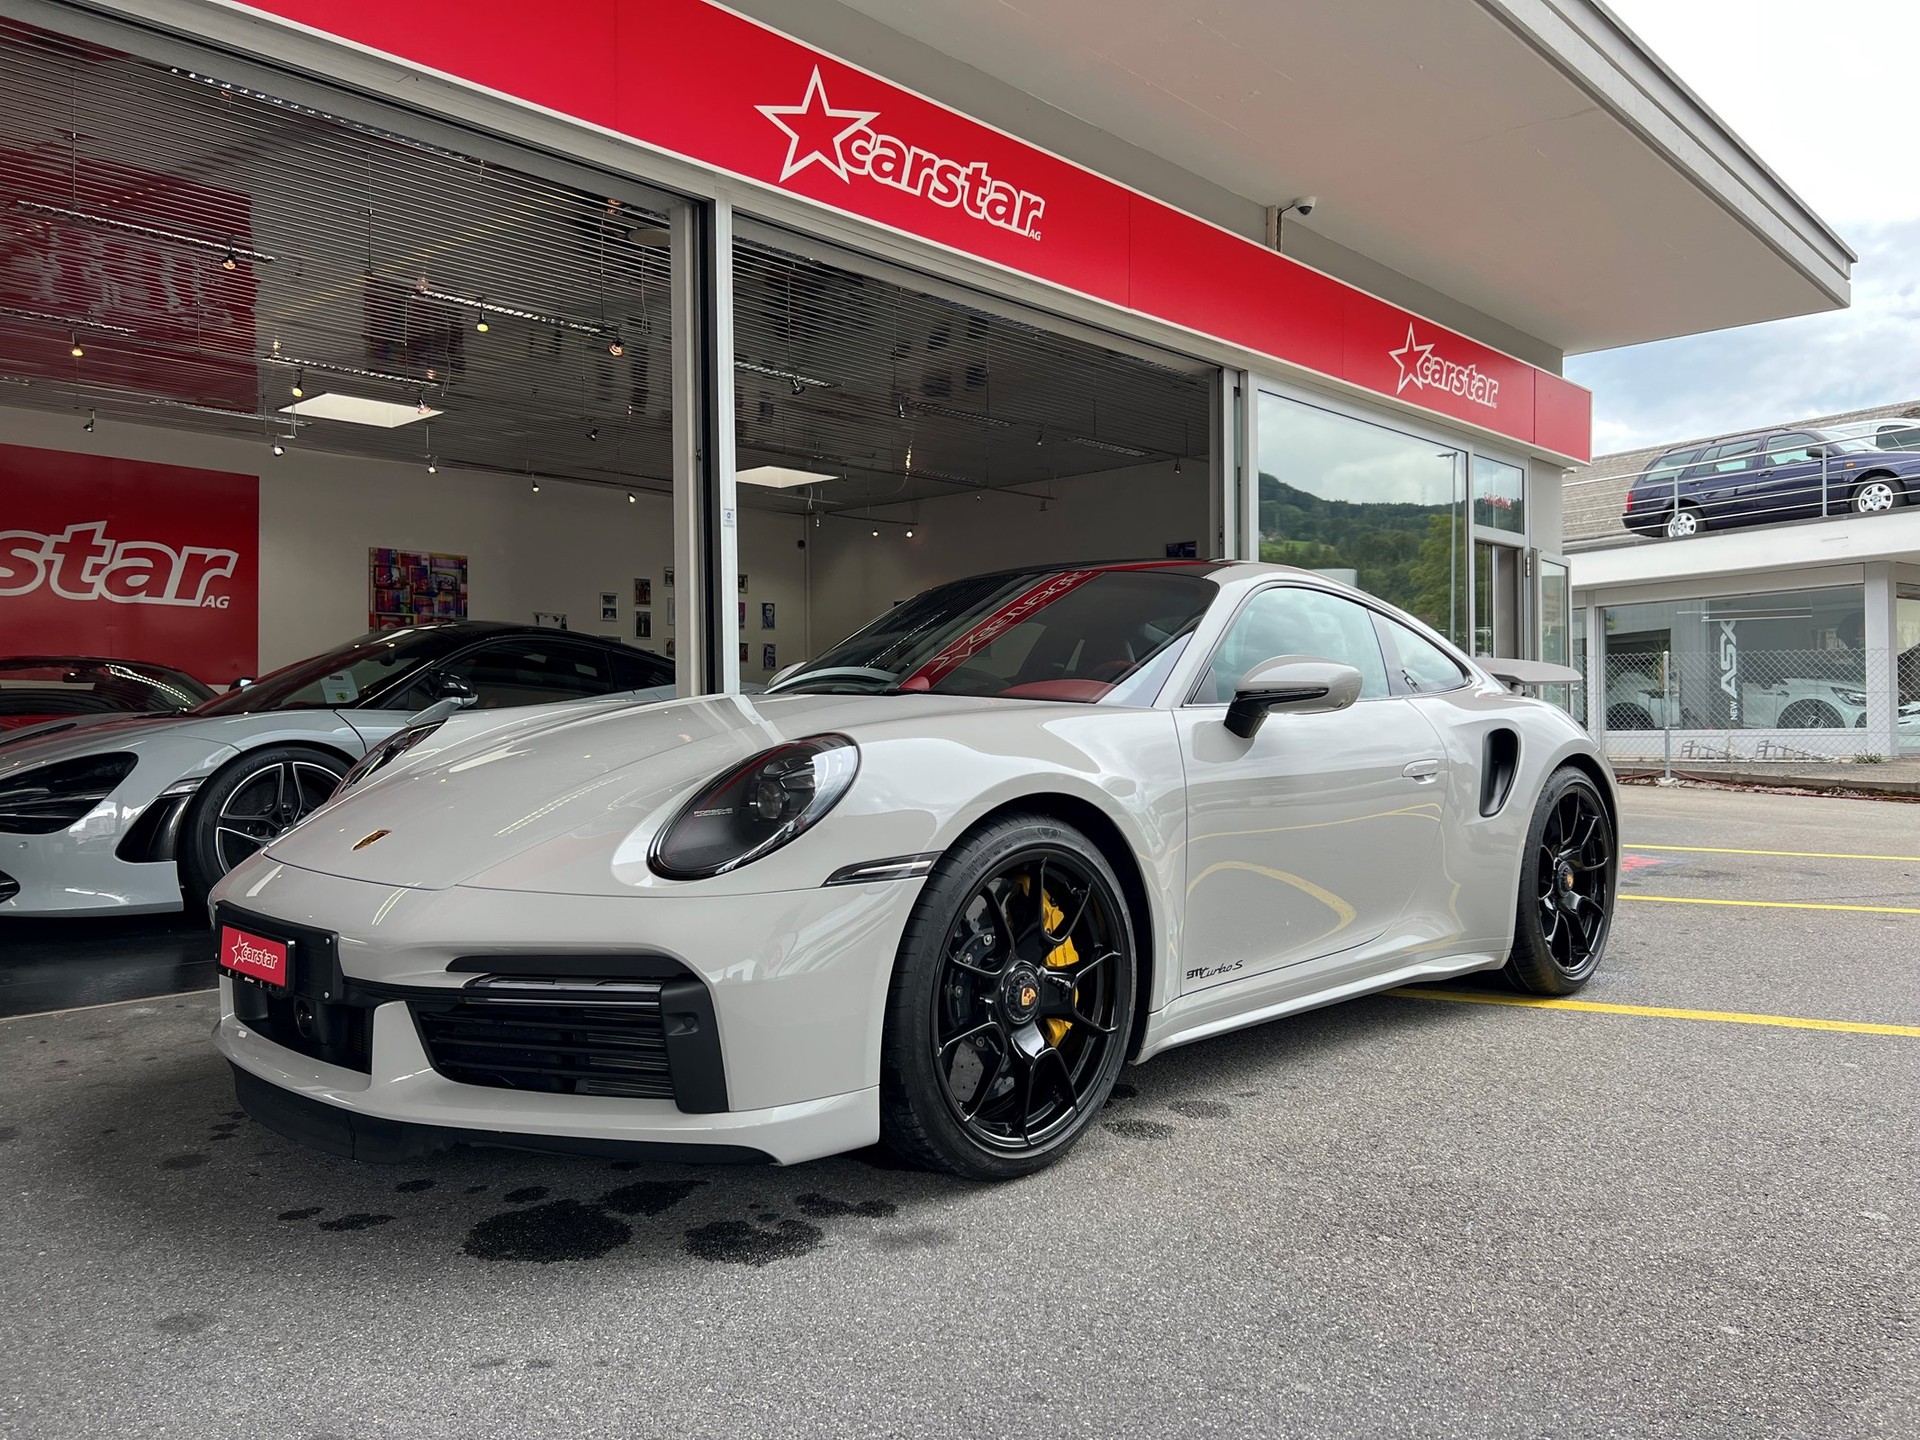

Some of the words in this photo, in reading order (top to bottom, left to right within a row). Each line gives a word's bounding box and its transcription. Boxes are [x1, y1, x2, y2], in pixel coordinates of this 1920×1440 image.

[841, 124, 1046, 237] carstar
[1028, 229, 1042, 242] AG
[1418, 353, 1499, 407] carstar
[202, 595, 230, 609] AG
[1720, 620, 1738, 699] ASX
[1729, 700, 1738, 720] NEW
[242, 945, 278, 970] carstar
